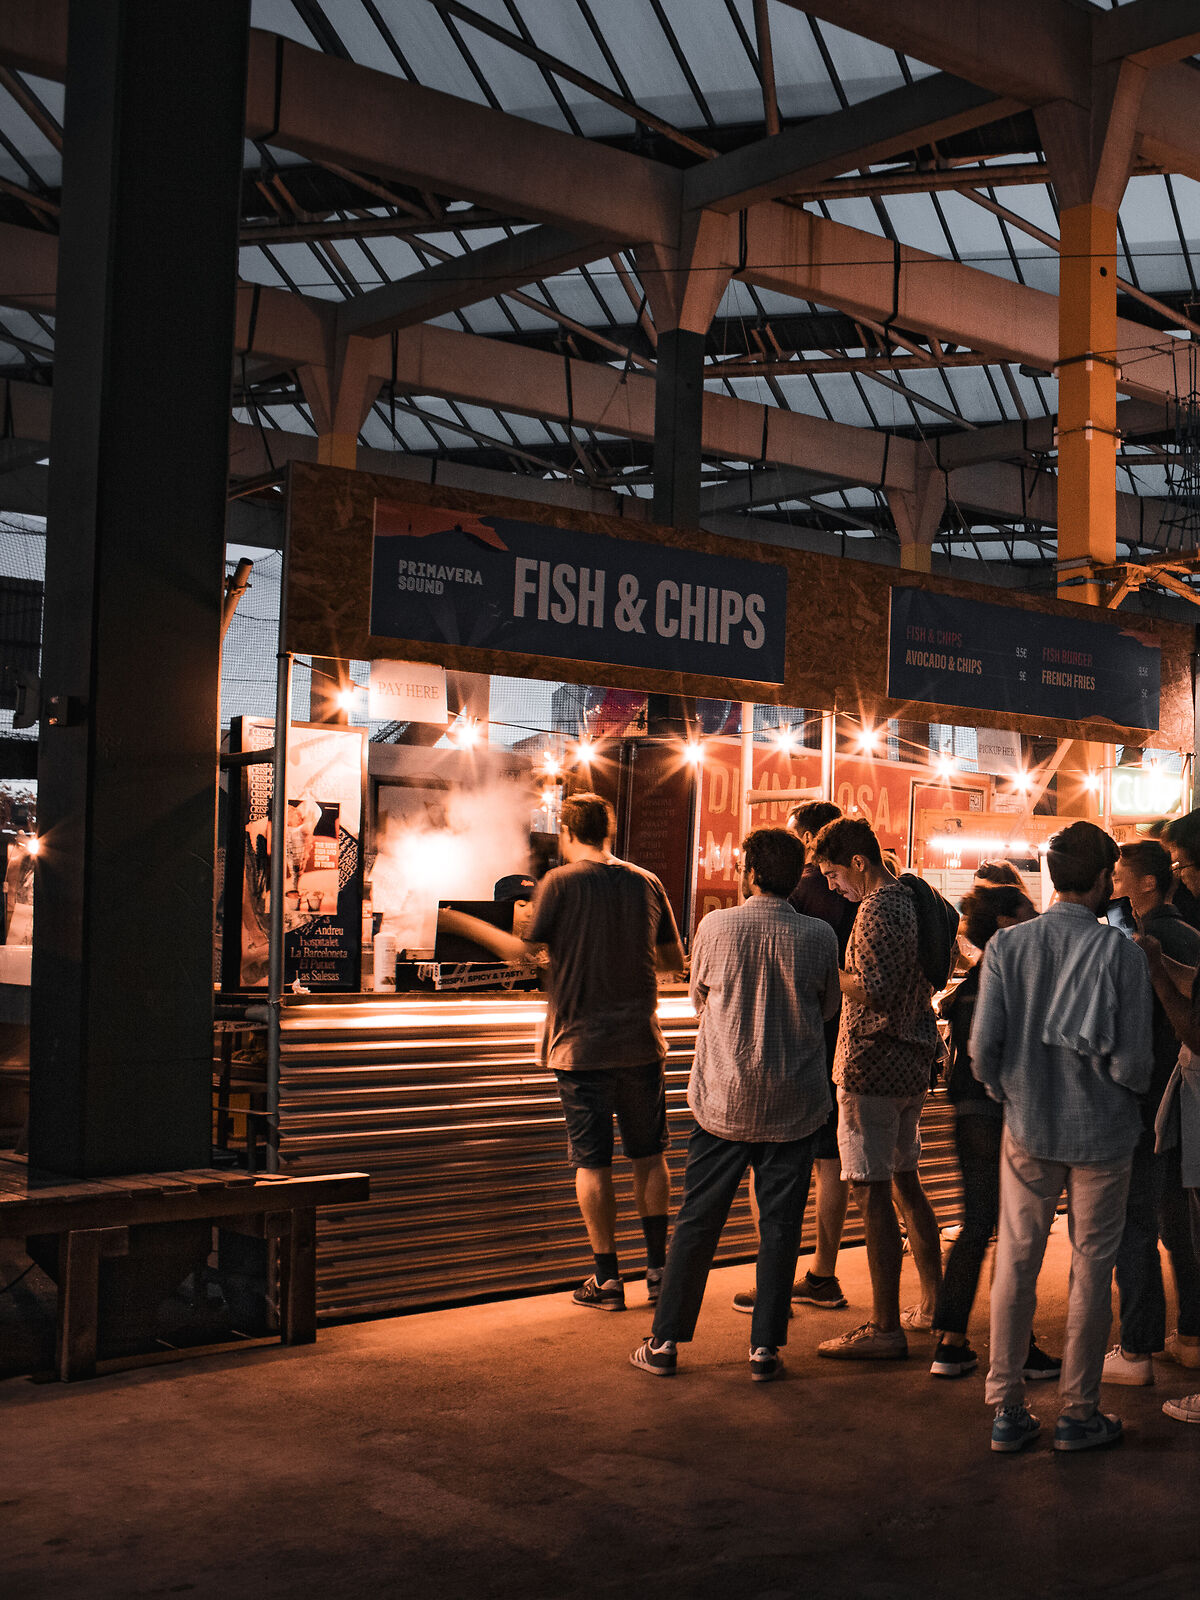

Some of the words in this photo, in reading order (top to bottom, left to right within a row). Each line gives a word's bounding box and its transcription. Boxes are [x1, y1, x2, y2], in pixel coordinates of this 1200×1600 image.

[398, 559, 484, 586] PRIMAVERA
[397, 575, 445, 595] SOUND
[513, 556, 605, 628] FISH
[614, 574, 647, 634] &
[655, 580, 766, 649] CHIPS
[906, 626, 926, 642] FISH
[928, 629, 935, 642] &
[936, 630, 963, 649] CHIPS
[905, 649, 947, 670] AVOCADO
[948, 656, 955, 671] &
[956, 657, 983, 675] CHIPS
[1042, 648, 1060, 664] FISH
[1062, 650, 1093, 668] BURGER
[377, 681, 403, 697] PAY
[405, 683, 440, 699] HERE
[1041, 670, 1072, 688] FRENCH
[1073, 673, 1096, 691] FRIES
[315, 925, 344, 935] Andreu
[291, 947, 302, 958] La
[303, 947, 348, 958] Barceloneta
[311, 970, 340, 981] Salesas
[468, 974, 491, 982] SPICY
[500, 970, 524, 978] TASTY
